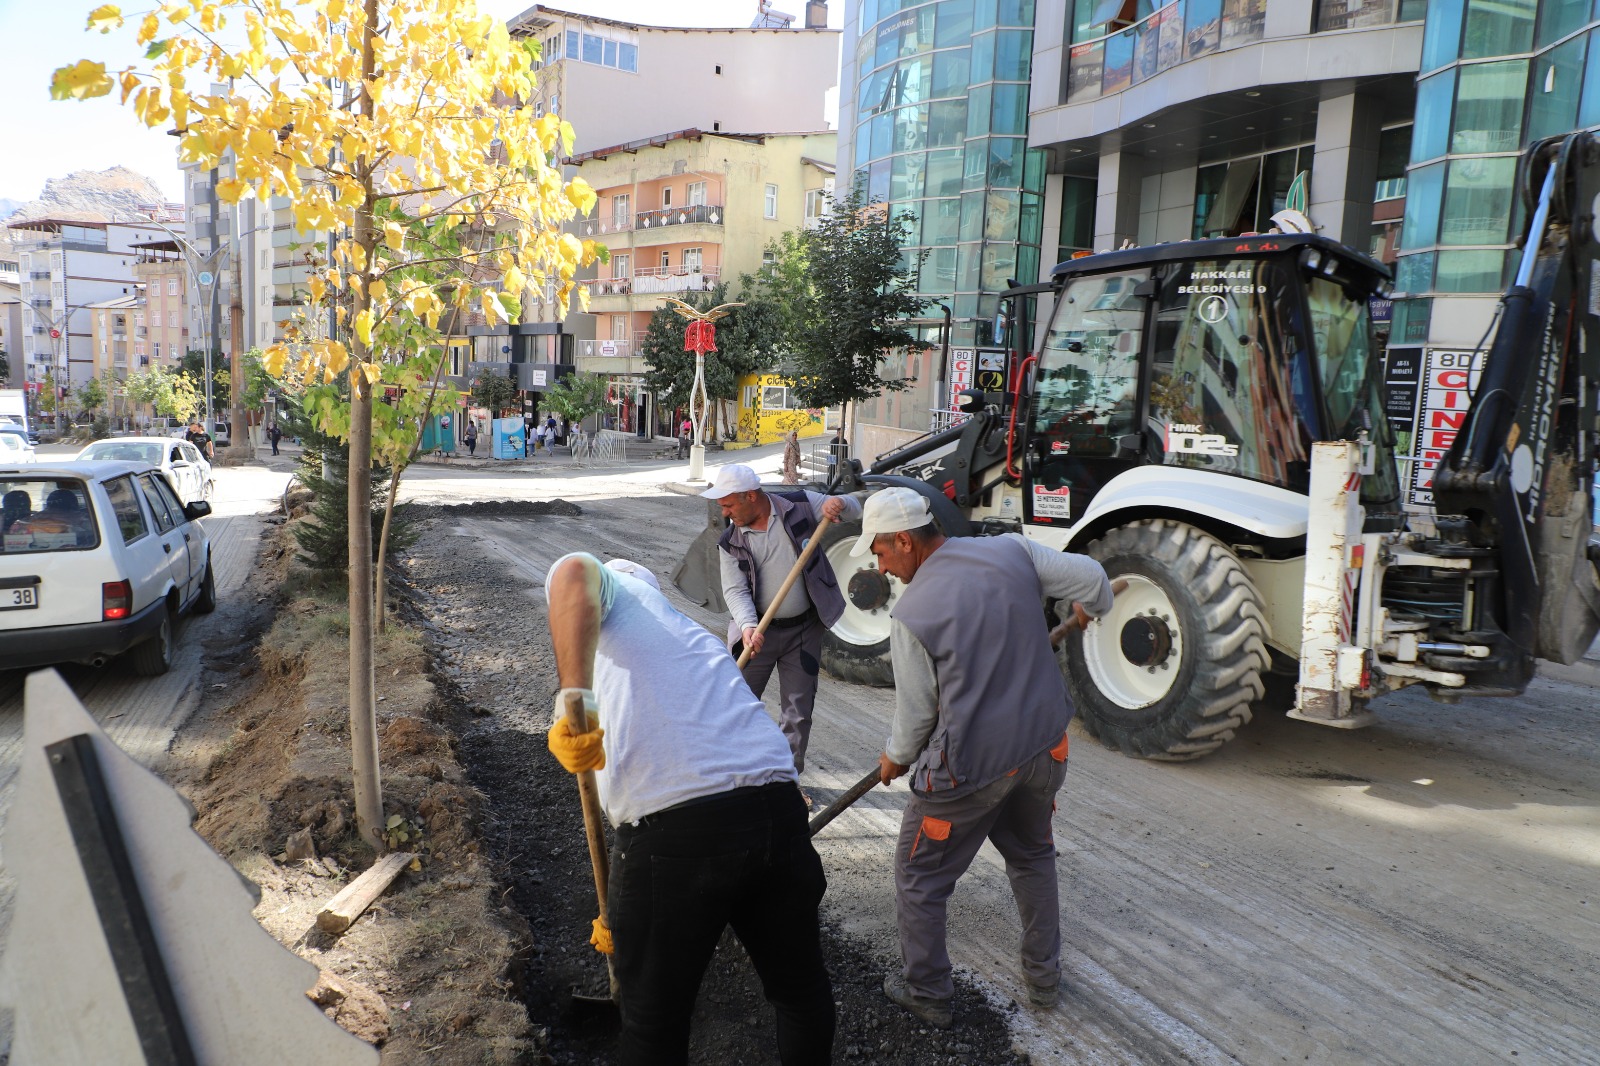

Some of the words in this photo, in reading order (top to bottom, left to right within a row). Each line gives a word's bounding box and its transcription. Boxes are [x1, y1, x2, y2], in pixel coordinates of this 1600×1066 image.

[1190, 269, 1251, 279] HAKKARİ
[1178, 283, 1254, 293] BELEDİYESİ
[1207, 298, 1218, 320] 1
[956, 351, 969, 360] 8D
[1440, 353, 1472, 368] 8D
[1169, 423, 1202, 433] HMK
[1423, 370, 1469, 487] CINEM
[12, 589, 32, 605] 38
